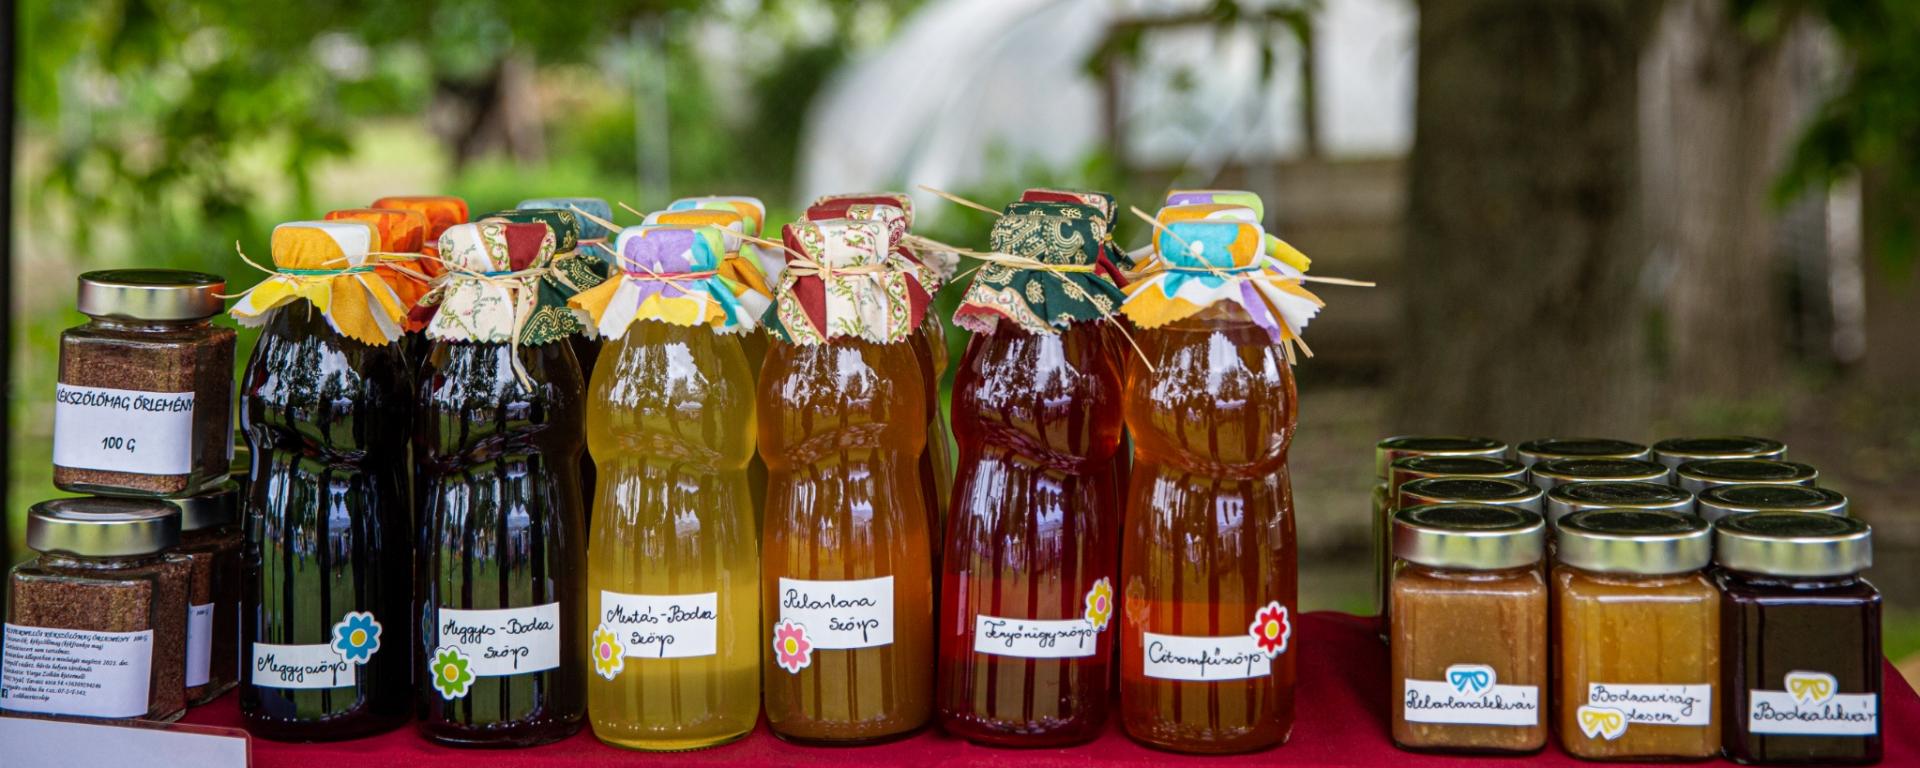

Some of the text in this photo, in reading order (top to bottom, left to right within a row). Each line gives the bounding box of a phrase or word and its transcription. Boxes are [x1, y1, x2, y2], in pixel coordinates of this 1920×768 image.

[134, 394, 195, 413] ŐRLEMÉNY
[101, 436, 136, 453] 100 G
